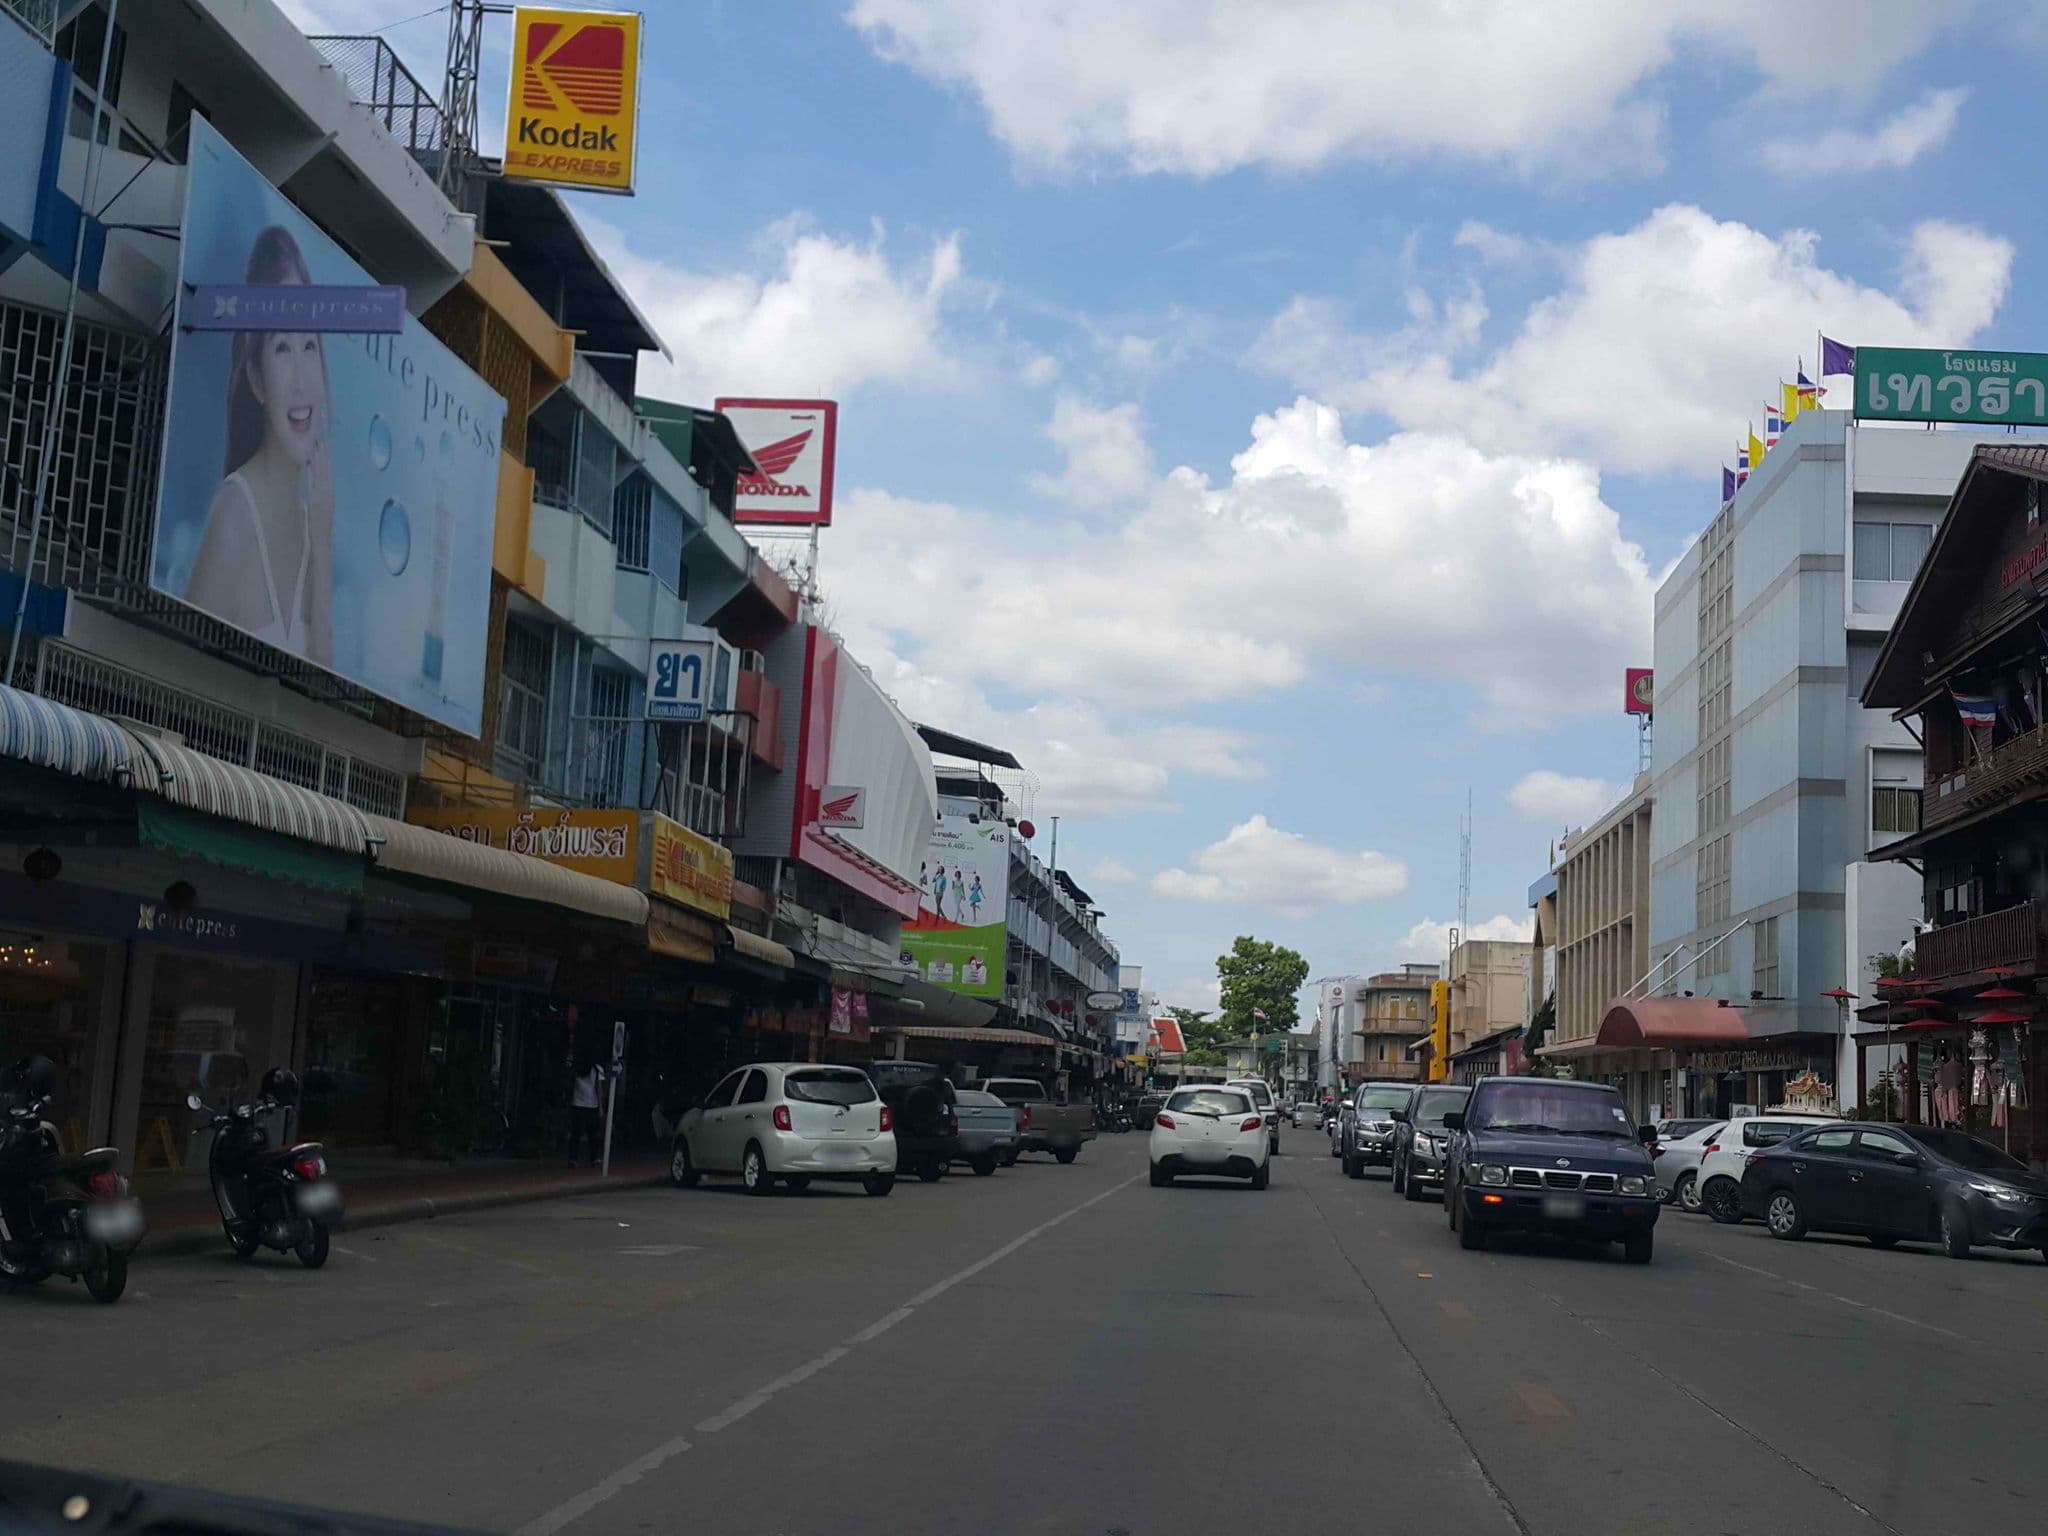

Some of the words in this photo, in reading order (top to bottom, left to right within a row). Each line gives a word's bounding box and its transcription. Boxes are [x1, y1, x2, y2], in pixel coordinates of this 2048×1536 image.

[518, 116, 617, 152] Kodak
[526, 153, 621, 178] EXPRESS
[311, 300, 384, 318] press
[1942, 352, 2017, 373] โรงแรม
[422, 374, 496, 458] press
[654, 652, 702, 699] ยา
[990, 833, 1005, 843] AIS
